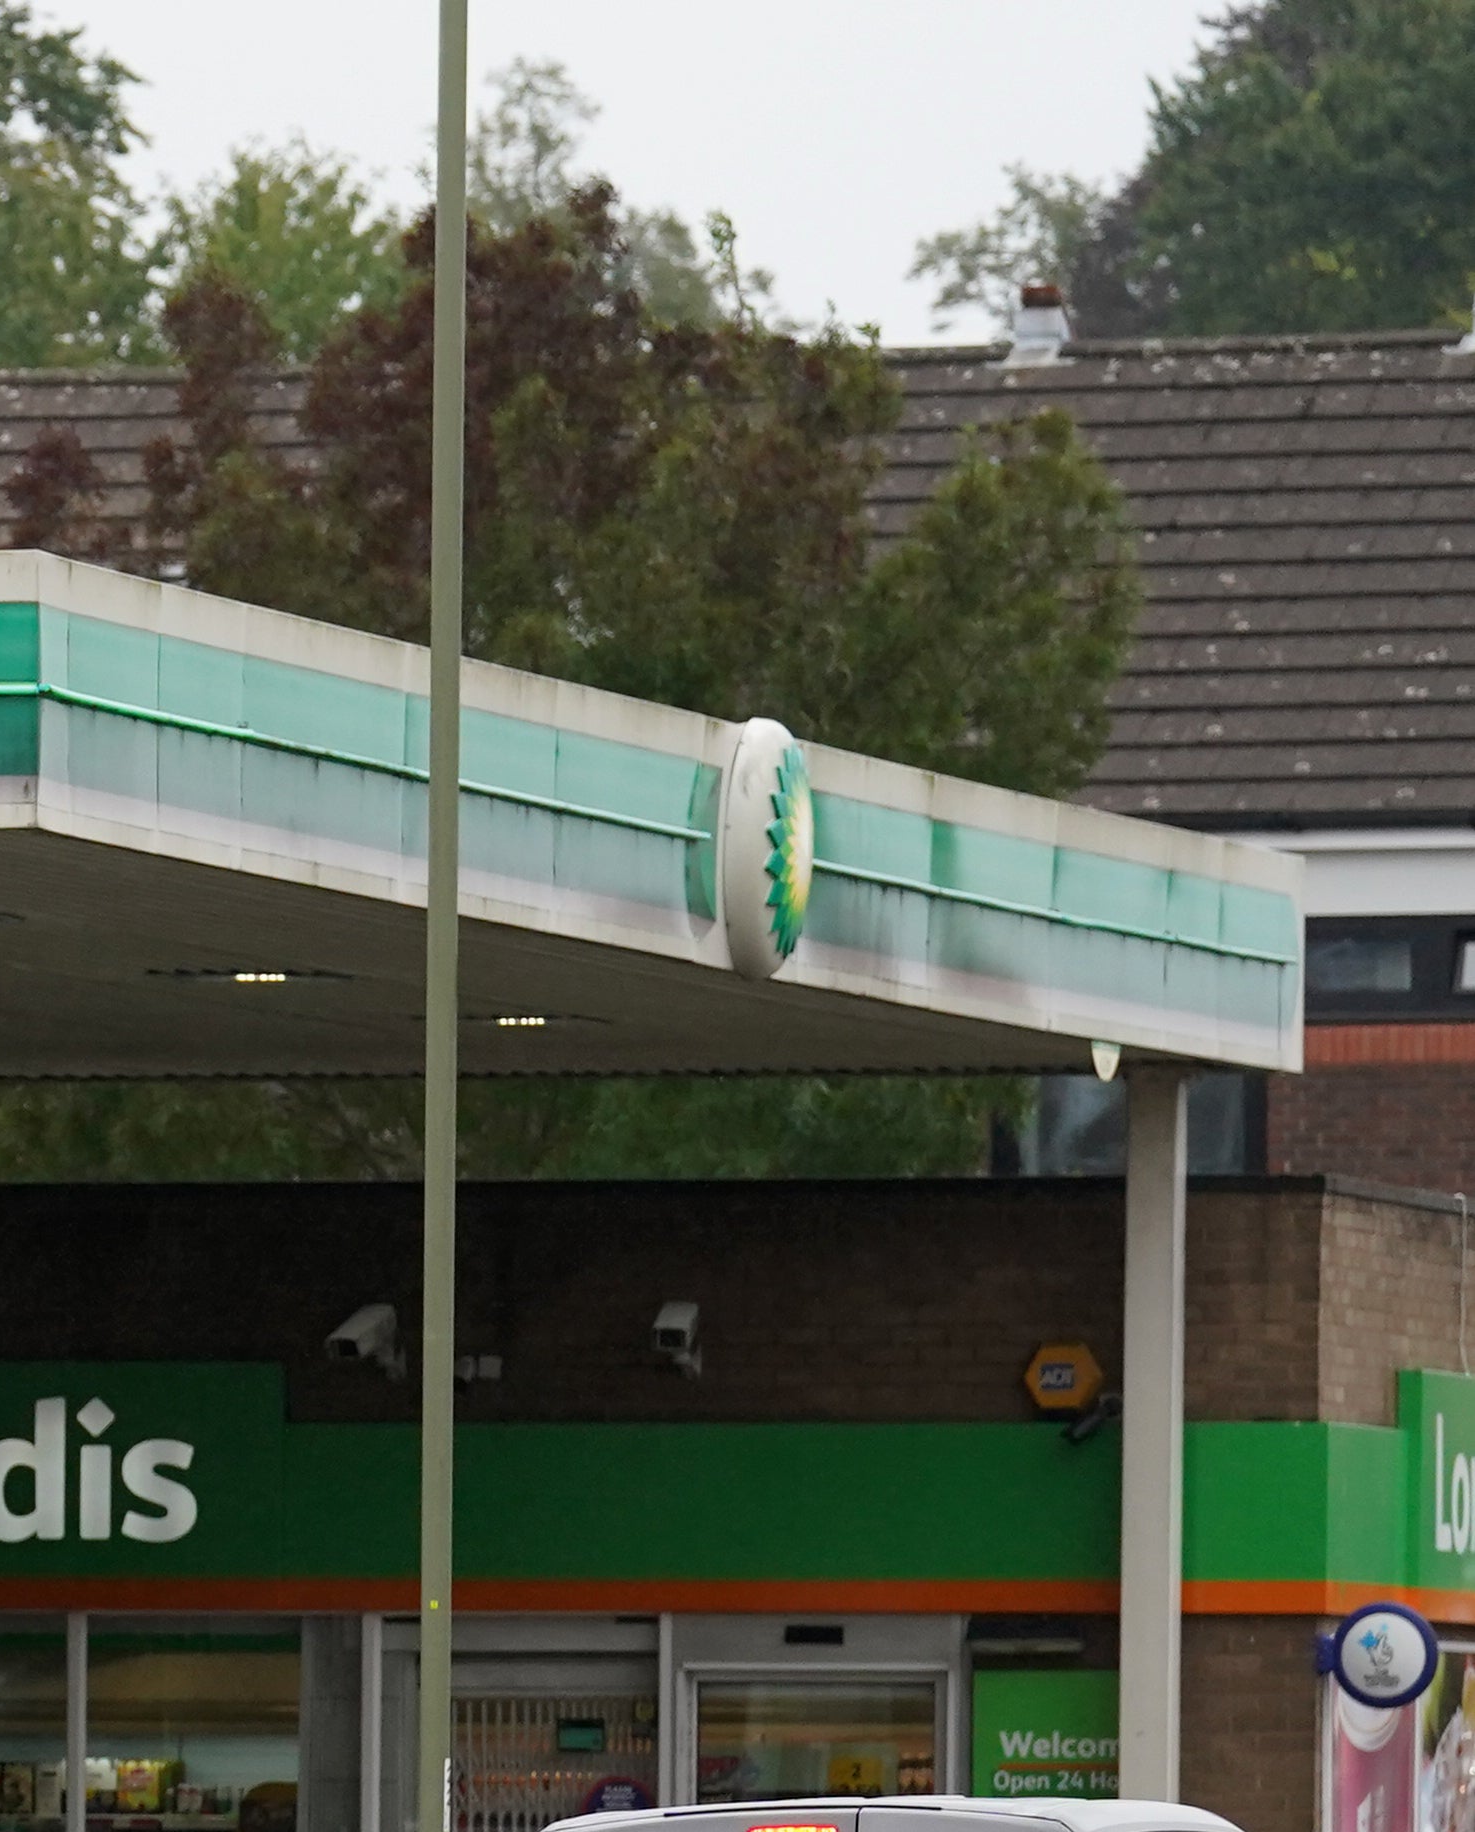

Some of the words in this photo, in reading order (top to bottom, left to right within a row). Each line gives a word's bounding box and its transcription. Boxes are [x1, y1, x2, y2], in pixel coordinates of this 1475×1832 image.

[1434, 1412, 1475, 1556] Lo
[993, 1769, 1051, 1797] Open
[1056, 1769, 1084, 1791] 24
